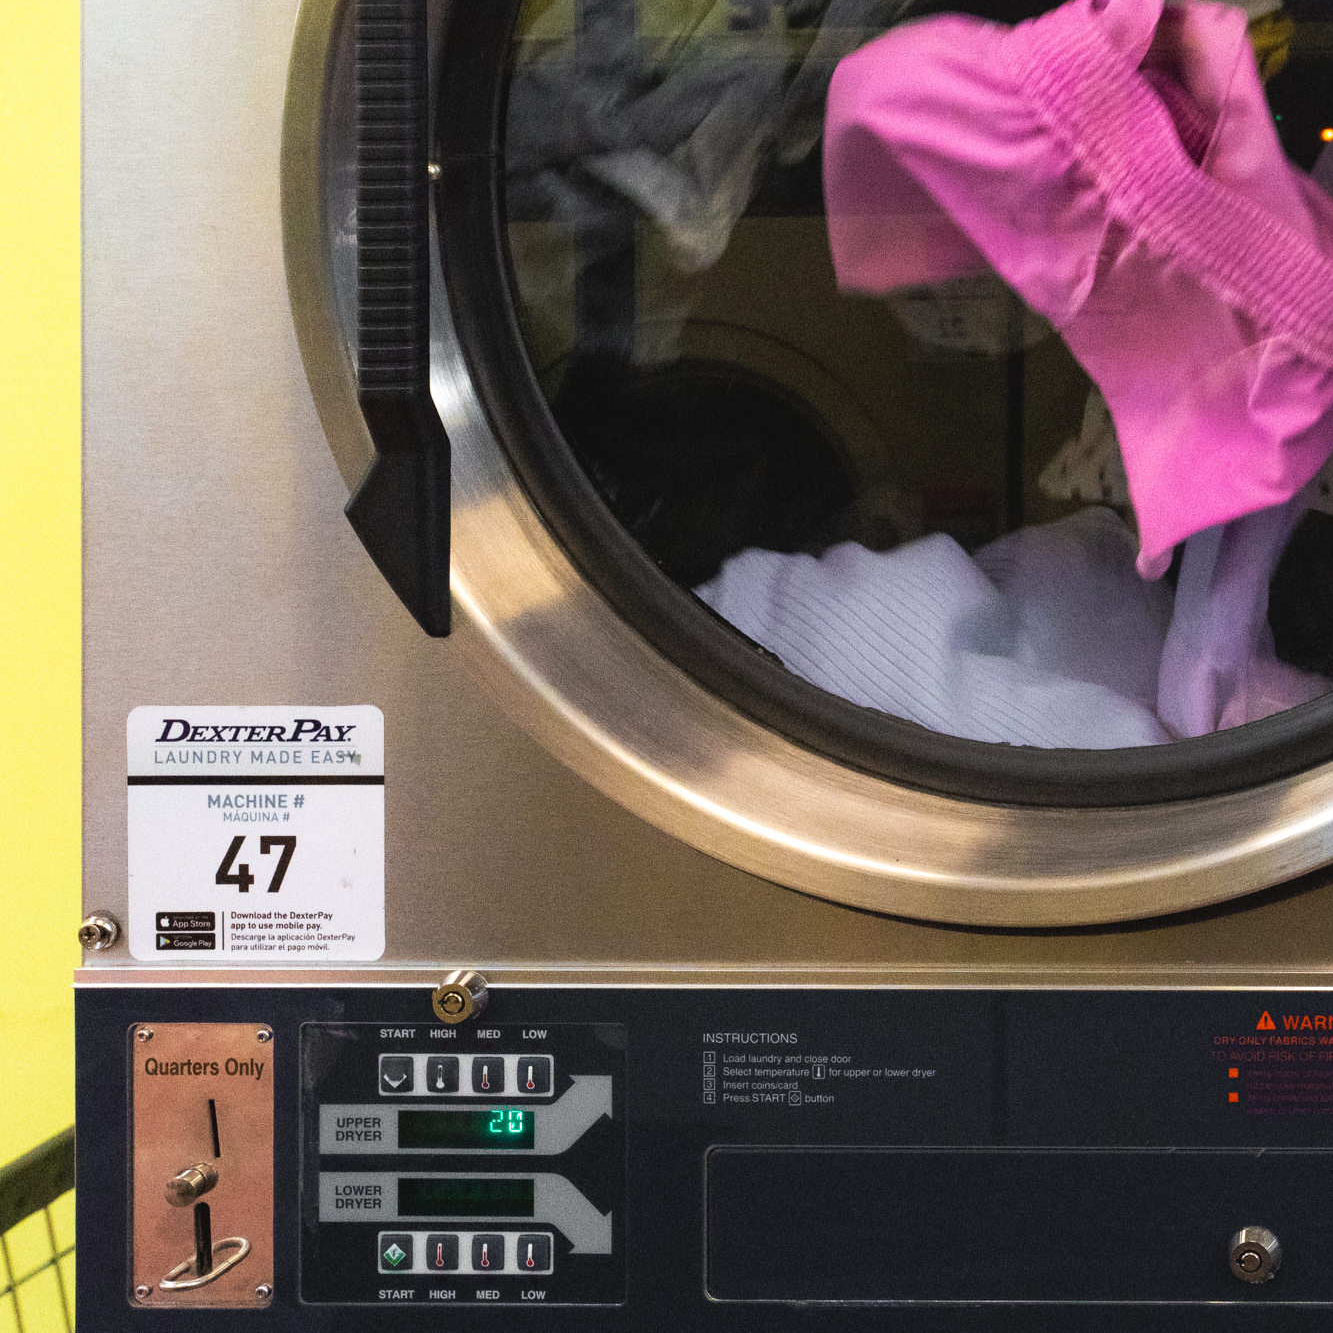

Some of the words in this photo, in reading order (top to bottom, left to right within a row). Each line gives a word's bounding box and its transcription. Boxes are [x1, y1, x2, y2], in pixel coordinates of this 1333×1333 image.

[154, 750, 242, 764] LAUNDRY
[251, 750, 302, 764] MADE
[311, 750, 357, 764] EASY
[207, 794, 287, 809] MACHINE
[293, 794, 305, 809] #
[223, 810, 279, 822] MÁQUINA
[215, 835, 297, 893] 47
[230, 911, 271, 920] Download
[273, 911, 287, 920] the
[289, 911, 333, 921] DexterPay
[230, 923, 245, 931] app
[248, 922, 257, 930] to
[275, 921, 304, 930] mobile
[230, 933, 267, 942] Descarge
[268, 933, 275, 941] la
[317, 933, 355, 943] DexterPay
[380, 1029, 415, 1039] START
[430, 1029, 457, 1039] HIGH
[477, 1029, 501, 1039] MED
[522, 1029, 547, 1039] LOW
[702, 1033, 798, 1044] INSTRUCTIONS
[1213, 1036, 1237, 1046] DRY
[1238, 1036, 1268, 1046] ONLY
[1269, 1036, 1316, 1046] FABRICS
[723, 1054, 746, 1063] Load
[748, 1054, 782, 1065] laundry
[784, 1054, 802, 1063] and
[804, 1054, 828, 1063] close
[830, 1054, 851, 1063] door
[144, 1057, 220, 1077] Quarters
[225, 1057, 265, 1080] Only
[722, 1067, 752, 1077] Select
[754, 1067, 810, 1078] temperature
[829, 1067, 841, 1077] for
[844, 1069, 870, 1079] upper
[872, 1069, 882, 1077] or
[884, 1067, 909, 1077] lower
[912, 1067, 936, 1079] dryer
[723, 1080, 749, 1090] Insert
[751, 1080, 799, 1090] coins/card
[723, 1093, 750, 1102] Press
[751, 1093, 786, 1102] START
[804, 1093, 835, 1103] button
[336, 1117, 382, 1129] UPPER
[489, 1109, 523, 1133] 20
[335, 1130, 383, 1142] DRYER
[335, 1185, 382, 1197] LOWER
[335, 1198, 382, 1210] DRYER
[378, 1289, 415, 1300] START
[429, 1289, 456, 1300] HIGH
[476, 1289, 500, 1300] MED
[521, 1289, 546, 1300] LOW
